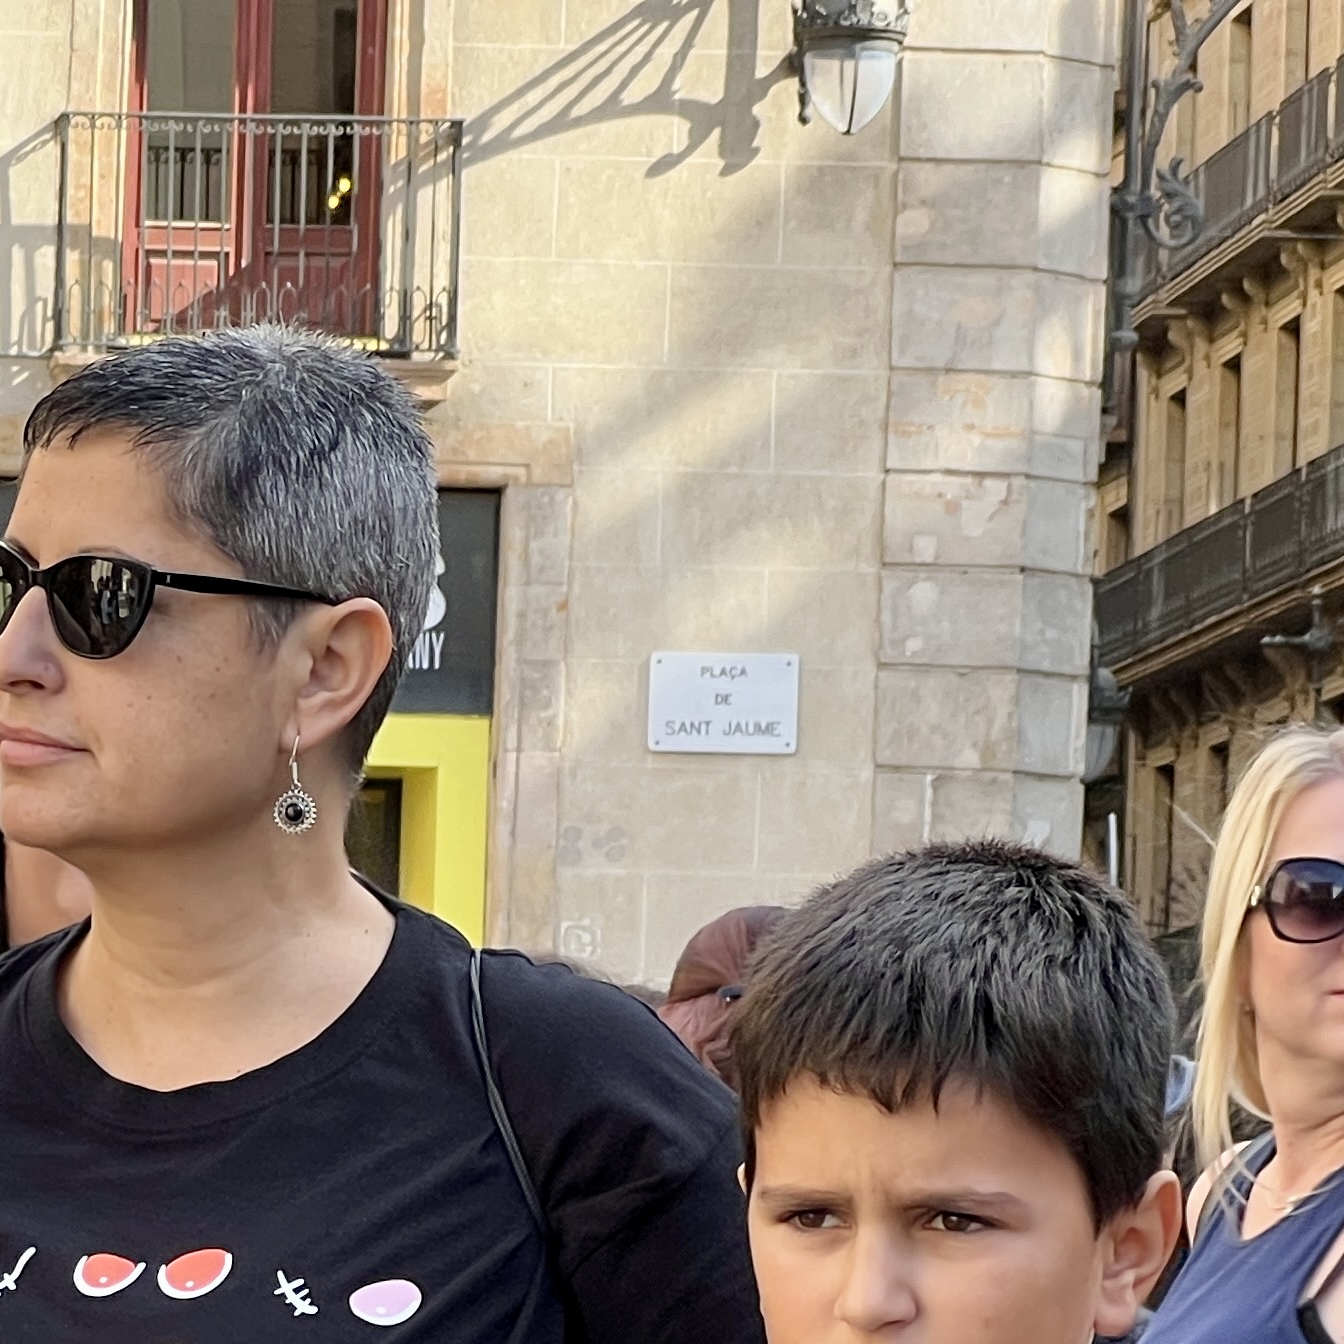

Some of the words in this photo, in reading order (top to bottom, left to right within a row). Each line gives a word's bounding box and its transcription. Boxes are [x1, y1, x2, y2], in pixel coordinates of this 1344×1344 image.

[700, 665, 748, 680] PLAÇA
[714, 692, 732, 706] DE
[665, 720, 713, 736] SANT
[722, 720, 781, 737] JAUME
